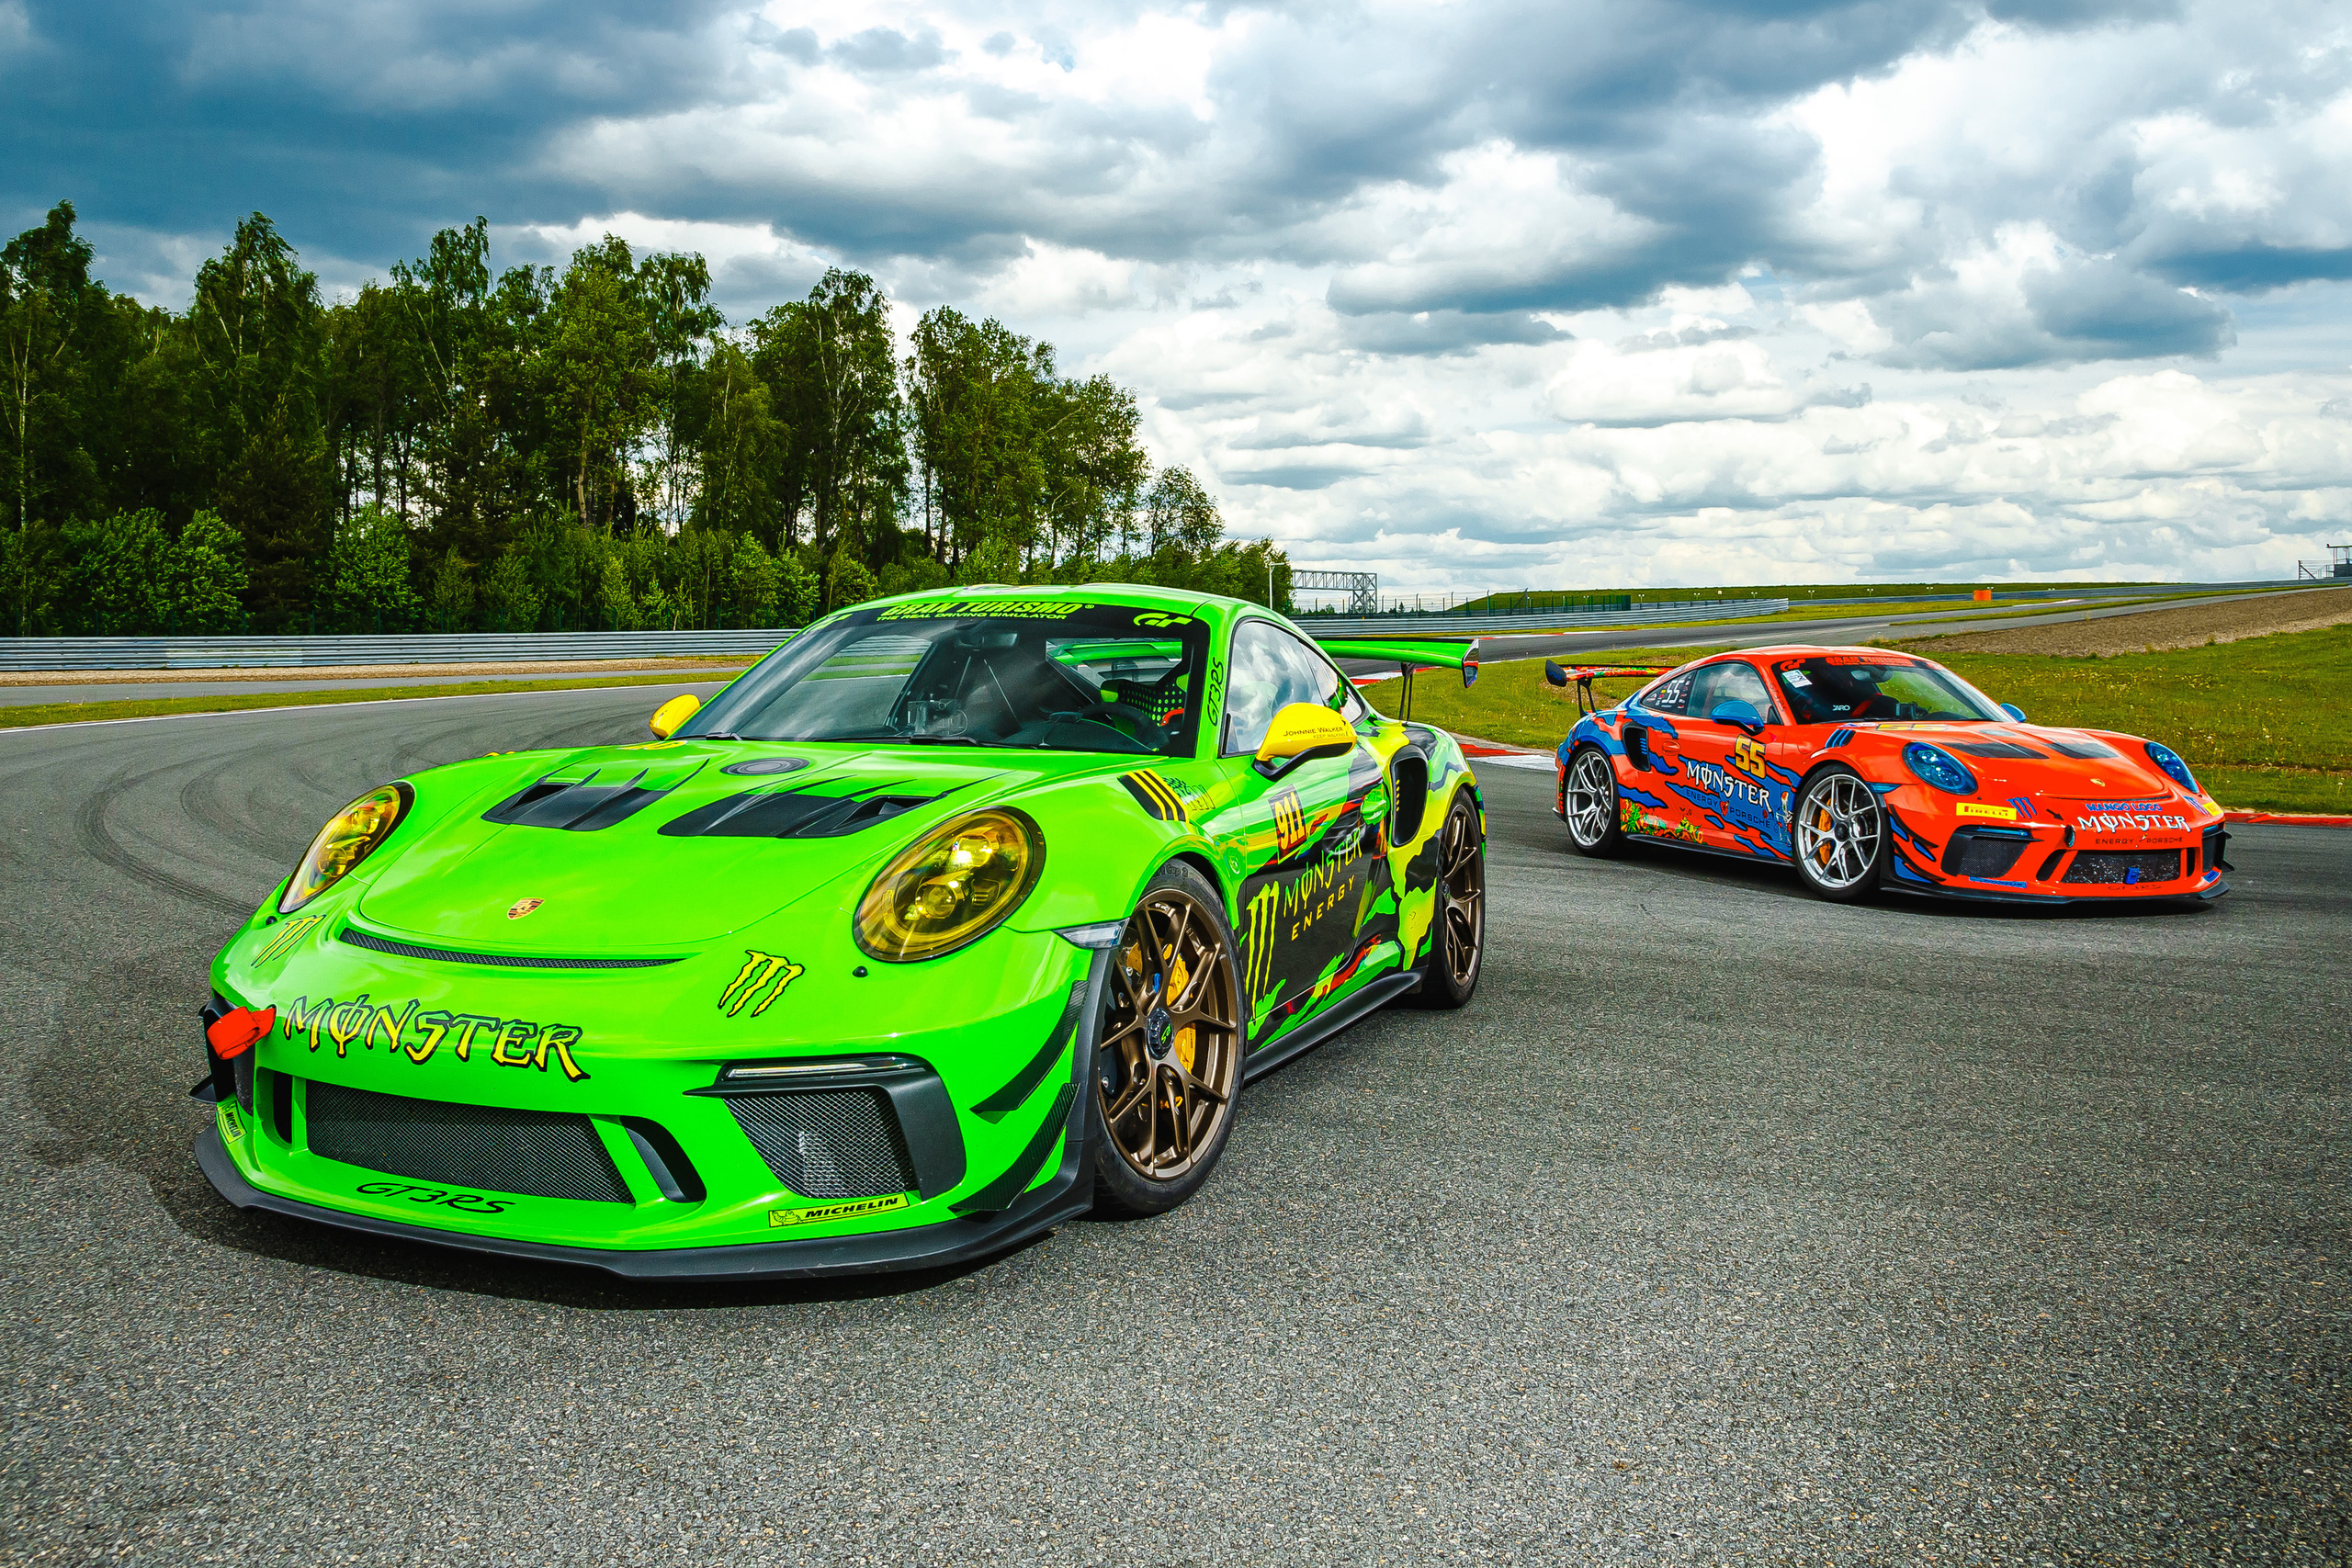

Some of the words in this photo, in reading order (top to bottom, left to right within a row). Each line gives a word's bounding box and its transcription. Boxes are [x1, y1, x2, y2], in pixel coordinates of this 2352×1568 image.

[880, 602, 958, 617] GRAN
[989, 612, 1068, 620] SIMULATOR
[1207, 657, 1225, 727] GT3RS
[1661, 680, 1685, 704] 55
[1283, 728, 1317, 737] JOHNNIE
[1735, 733, 1767, 779] 55
[1274, 791, 1306, 851] 911
[1686, 789, 1718, 807] ENERGY
[1729, 807, 1771, 828] PORSCHE
[1166, 863, 1182, 877] Cup
[1182, 866, 1189, 877] 2
[1291, 874, 1355, 942] ENERGY
[225, 1111, 242, 1138] MICHELIN
[356, 1182, 516, 1213] GT3RS
[805, 1197, 899, 1218] MICHELIN
